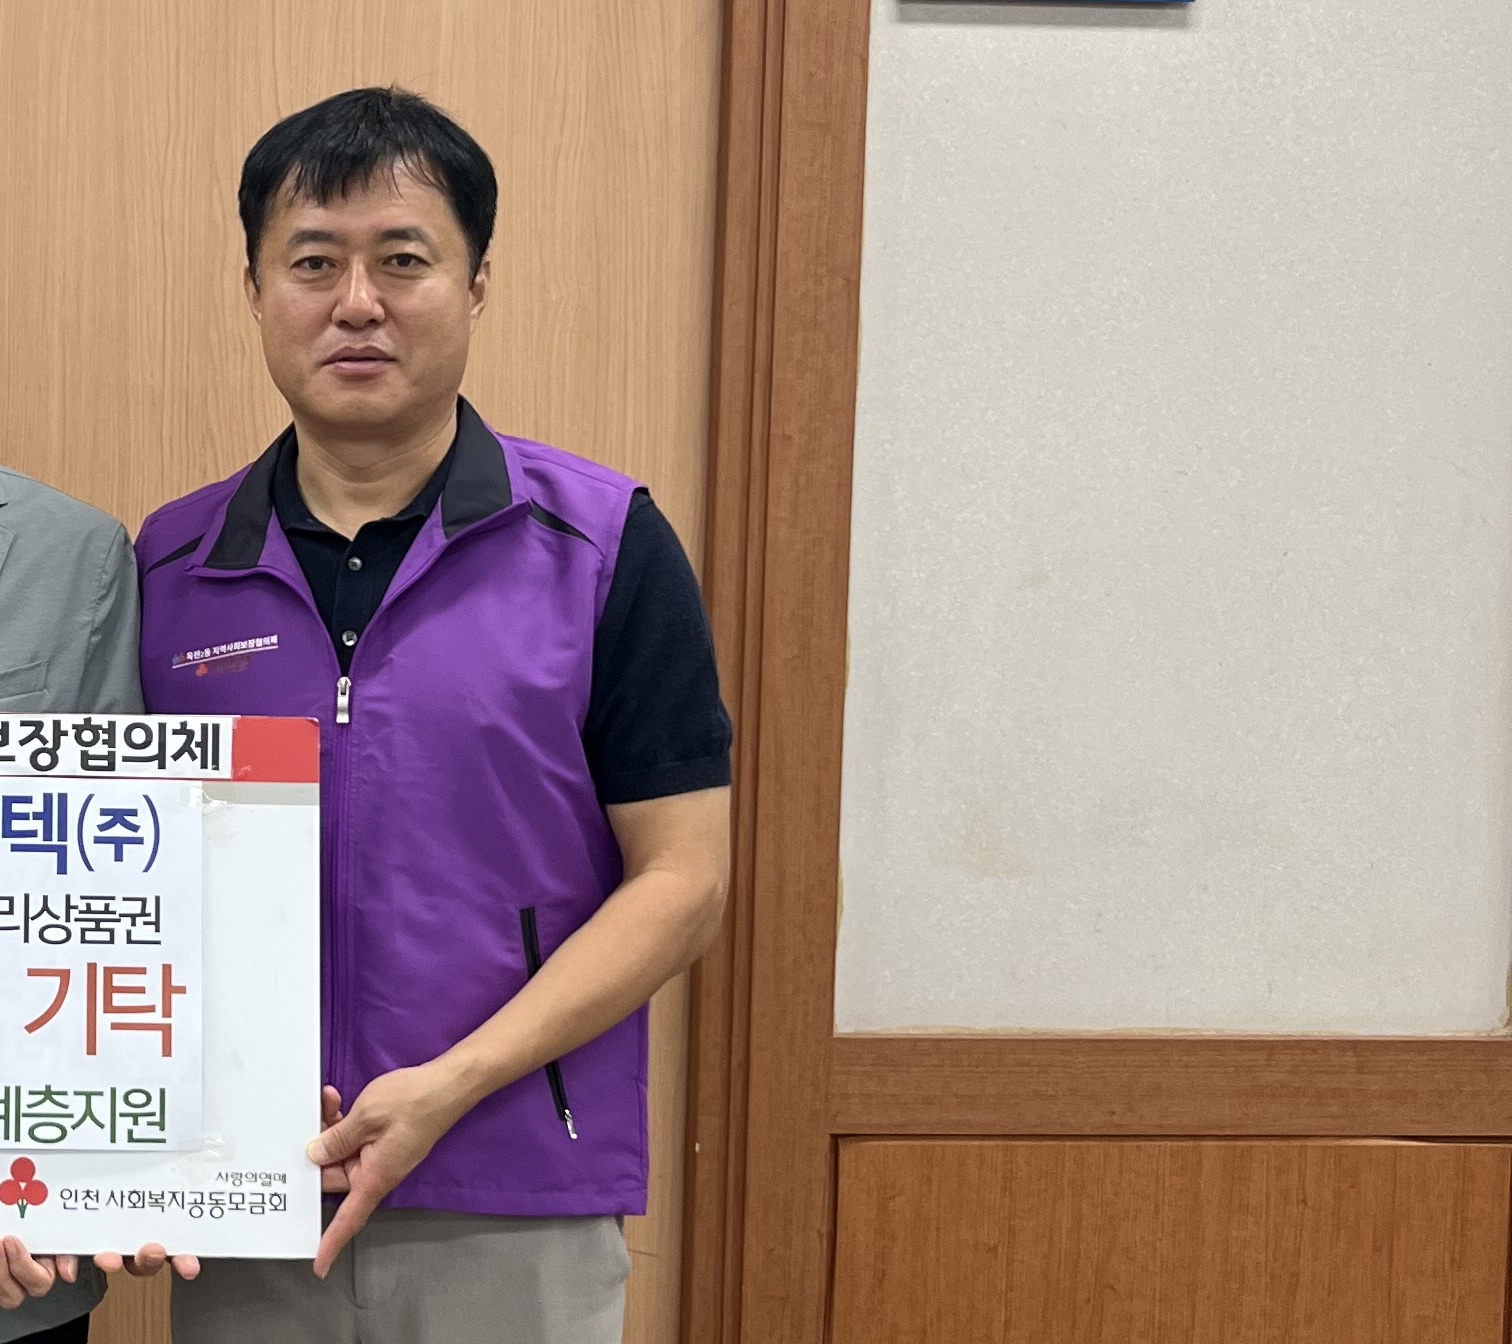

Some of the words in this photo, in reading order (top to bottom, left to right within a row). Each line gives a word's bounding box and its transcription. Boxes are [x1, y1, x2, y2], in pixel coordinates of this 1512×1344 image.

[23, 961, 187, 1058] 기탁
[215, 1171, 287, 1187] 사랑의열매
[59, 1188, 100, 1211] 인천
[105, 1189, 287, 1219] 사회복지공동모금회
